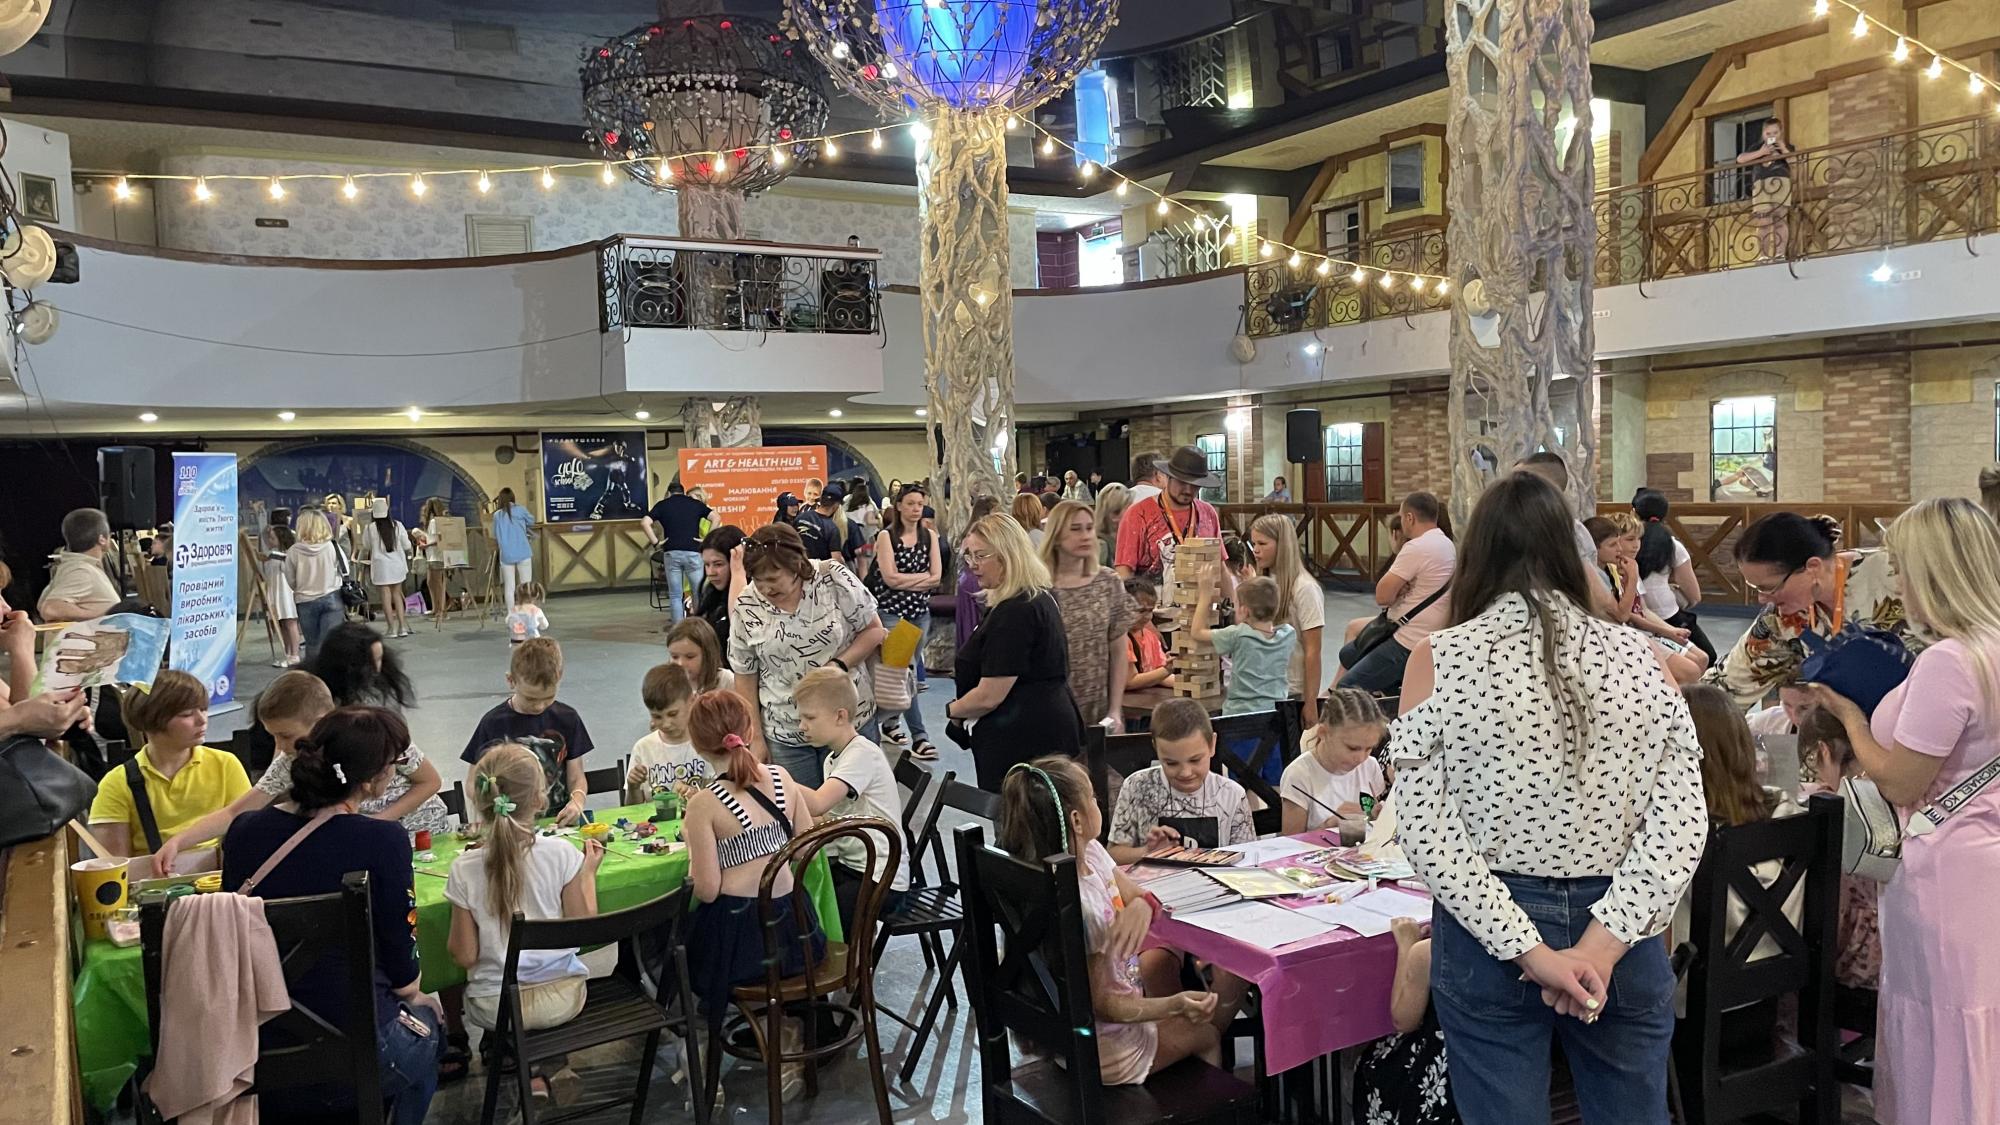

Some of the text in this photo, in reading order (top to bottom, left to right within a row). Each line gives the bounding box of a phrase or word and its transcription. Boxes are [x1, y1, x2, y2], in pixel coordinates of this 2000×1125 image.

[704, 457, 803, 468] ART & HEALTH HUB
[179, 466, 198, 480] 110
[728, 487, 777, 495] МАЛЮВАННЯ
[190, 543, 233, 560] Здоров'я
[179, 577, 225, 594] Провідний
[180, 594, 224, 610] виробник
[177, 609, 226, 626] лікарських
[184, 625, 218, 640] засобів
[1957, 763, 2000, 795] MICHAEL
